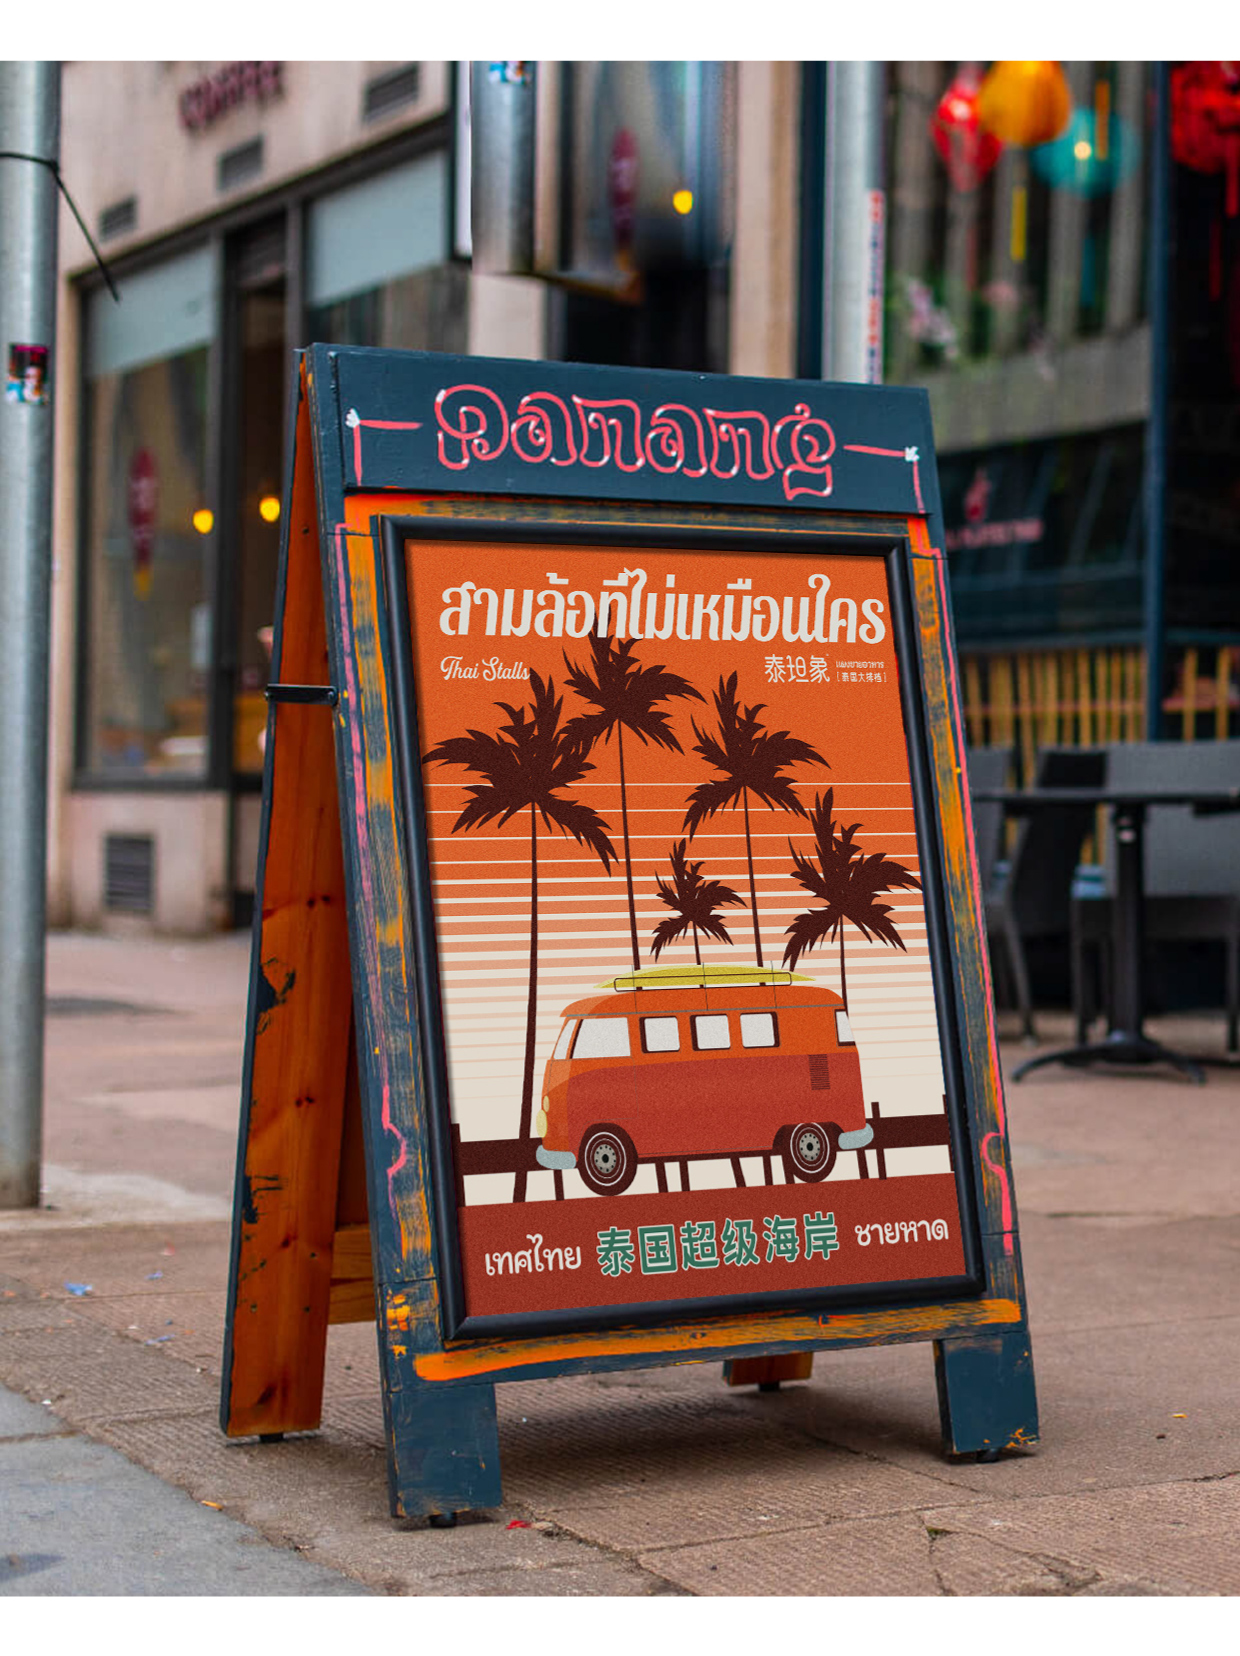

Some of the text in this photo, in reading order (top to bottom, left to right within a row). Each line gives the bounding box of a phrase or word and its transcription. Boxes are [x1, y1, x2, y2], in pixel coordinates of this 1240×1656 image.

[440, 656, 530, 681] Thai Stalls
[485, 1211, 949, 1277] เทศไทย 泰国超级海岸 ชายหาด
